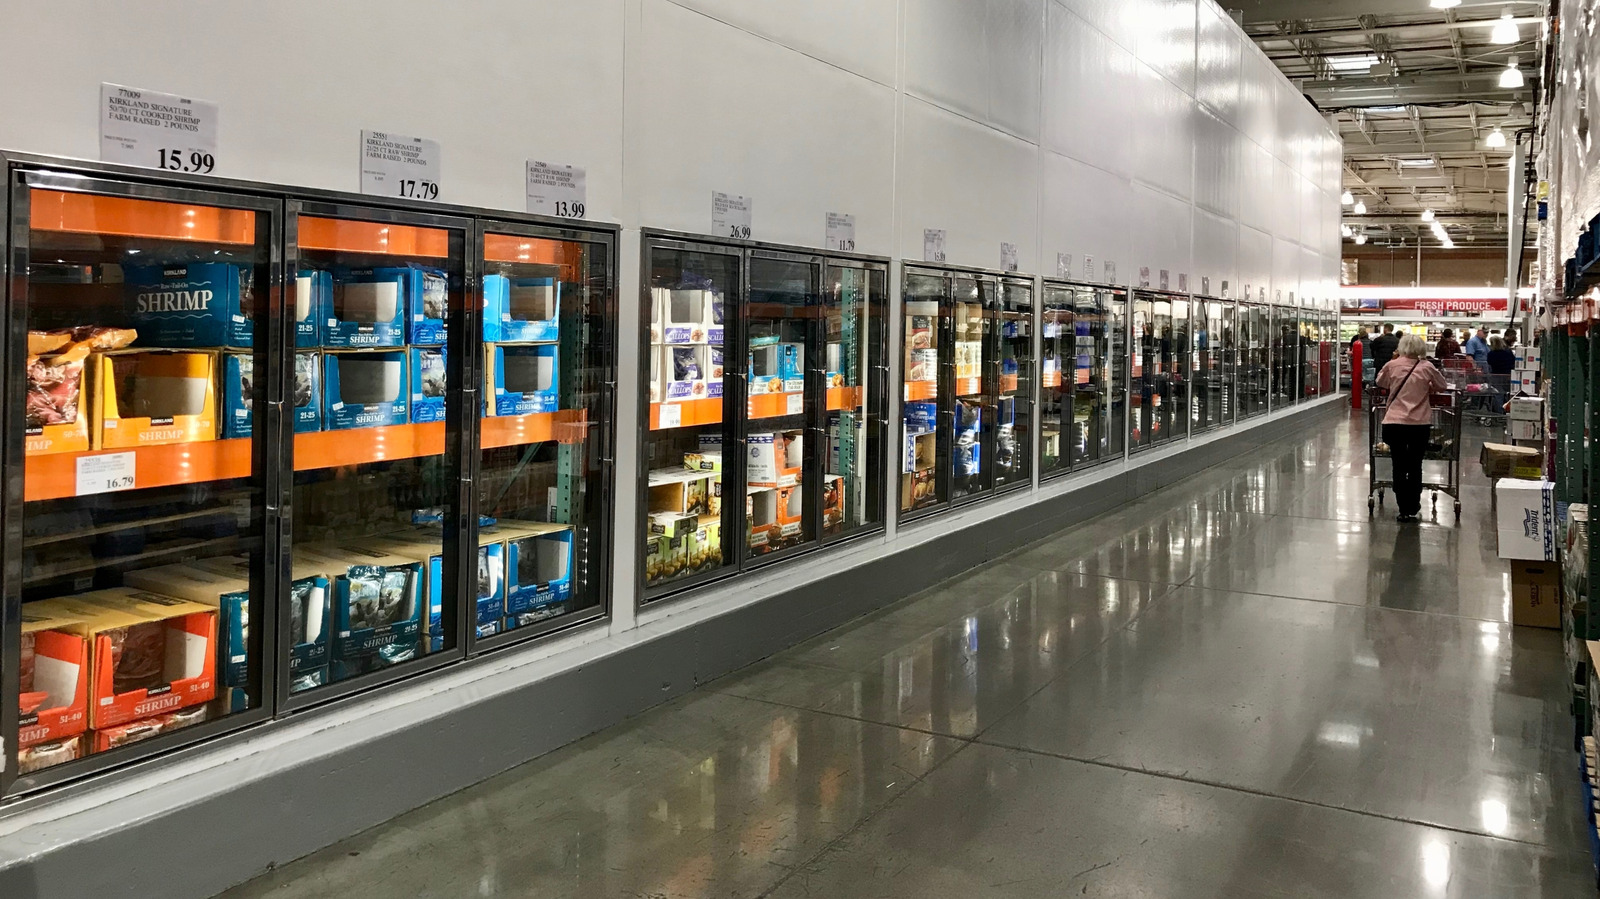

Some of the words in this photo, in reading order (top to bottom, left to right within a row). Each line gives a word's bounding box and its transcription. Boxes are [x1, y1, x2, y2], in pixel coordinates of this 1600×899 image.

[118, 88, 141, 99] 77009
[109, 97, 149, 109] KIRKLAND
[150, 103, 192, 116] SIGNATURE
[109, 112, 131, 122] FARM
[133, 115, 160, 126] RAISED
[170, 121, 199, 132] POUNDS
[129, 107, 139, 116] CT
[141, 109, 172, 121] COOKED
[174, 115, 200, 125] SHRIMP
[372, 131, 388, 140] 25551
[366, 138, 394, 148] KIRKLAND
[394, 143, 422, 153] SIGNATURE
[157, 148, 215, 174] 15.99
[366, 151, 382, 159] FARM
[382, 153, 401, 162] RAISED
[407, 157, 427, 166] POUNDS
[399, 179, 439, 200] 17.79
[555, 201, 585, 218] 13.99
[730, 225, 751, 239] 26.99
[839, 239, 855, 251] 11.79
[137, 289, 213, 313] SHRIMP
[1414, 301, 1444, 310] FRESH
[1446, 301, 1491, 310] PRODUCE
[298, 324, 313, 332] 21-25
[388, 328, 401, 336] 21-25
[350, 335, 380, 344] SHRIMP
[300, 411, 316, 419] 21-25
[355, 414, 385, 424] SHRIMP
[139, 429, 184, 441] SHRIMP
[26, 439, 53, 450] IMP
[106, 476, 134, 489] 16.79
[1531, 510, 1539, 536] Trident
[529, 592, 555, 605] SHRIMP
[404, 623, 418, 633] 21-25
[362, 634, 398, 649] SHRIMP
[134, 695, 182, 715] SHRIMP
[18, 727, 50, 743] RIMP
